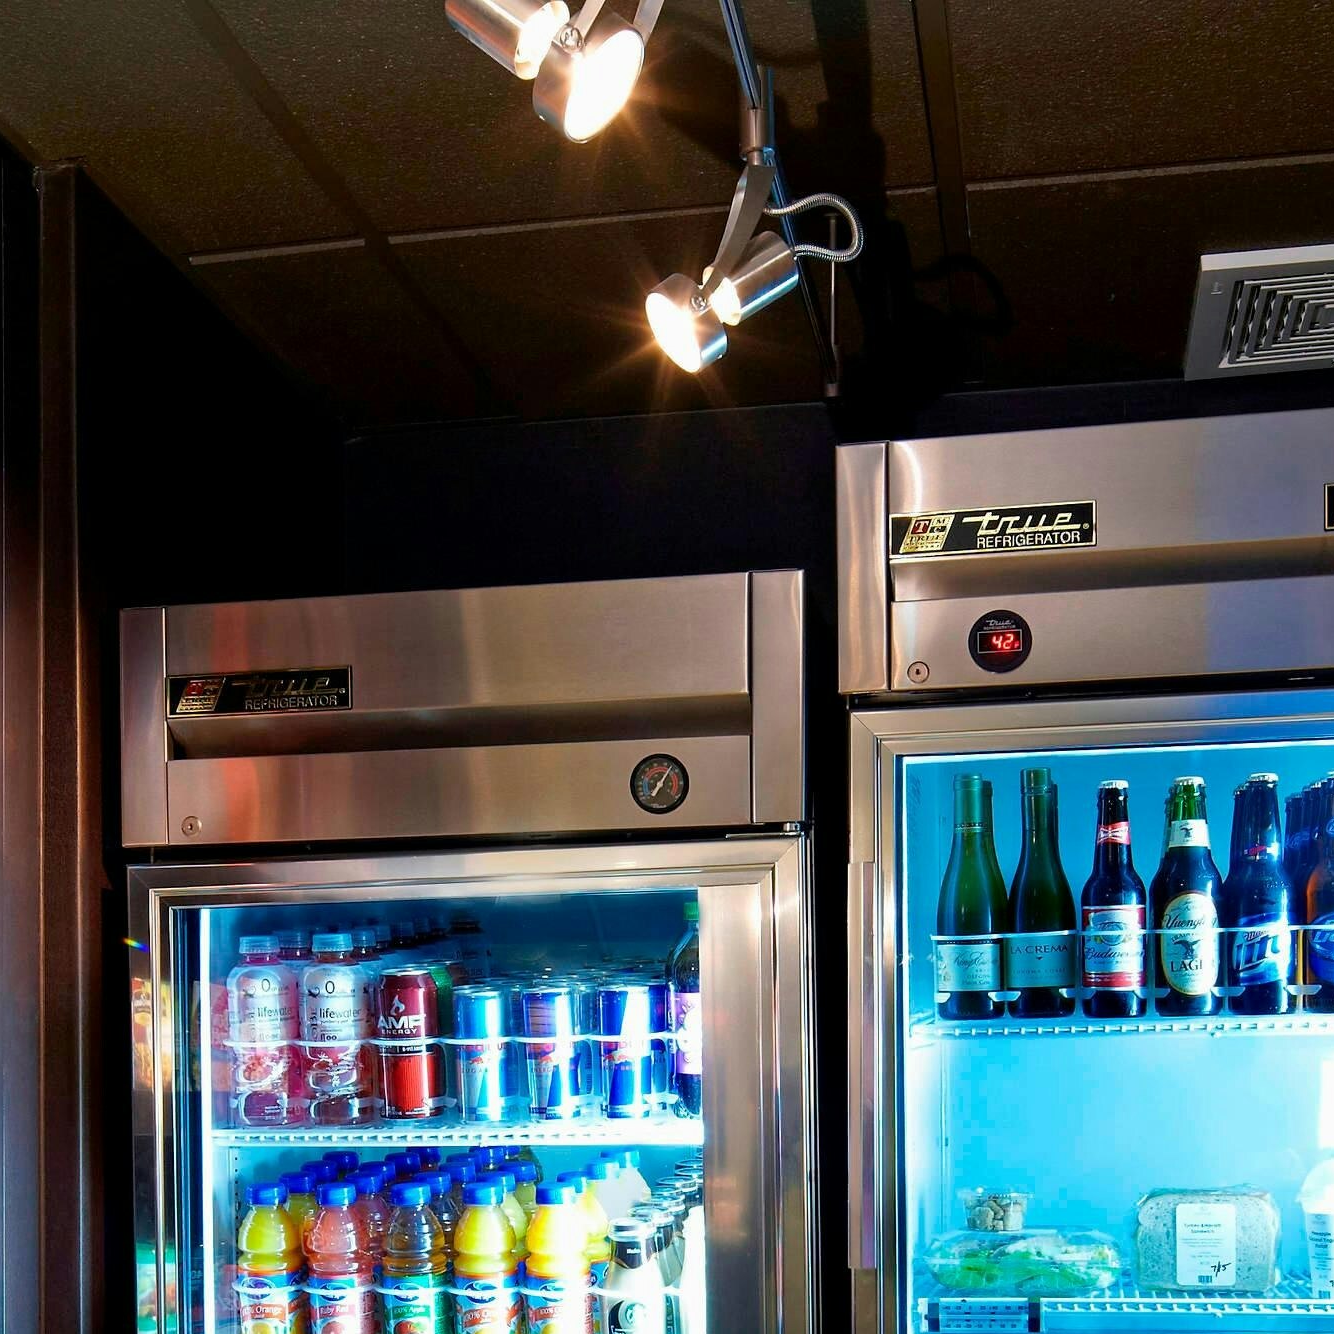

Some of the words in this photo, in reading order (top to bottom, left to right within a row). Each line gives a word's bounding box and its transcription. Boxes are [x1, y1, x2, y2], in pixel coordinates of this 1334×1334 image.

[962, 512, 1080, 536] true
[977, 532, 1080, 549] REFRIGERATOR
[992, 634, 1014, 649] 42
[245, 695, 338, 710] REFRIGERATOR
[1024, 943, 1068, 954] CREMA
[319, 1007, 361, 1019] lifewater
[378, 1014, 426, 1029] AMP
[256, 1306, 281, 1315] Orange
[319, 1306, 334, 1315] Ruby
